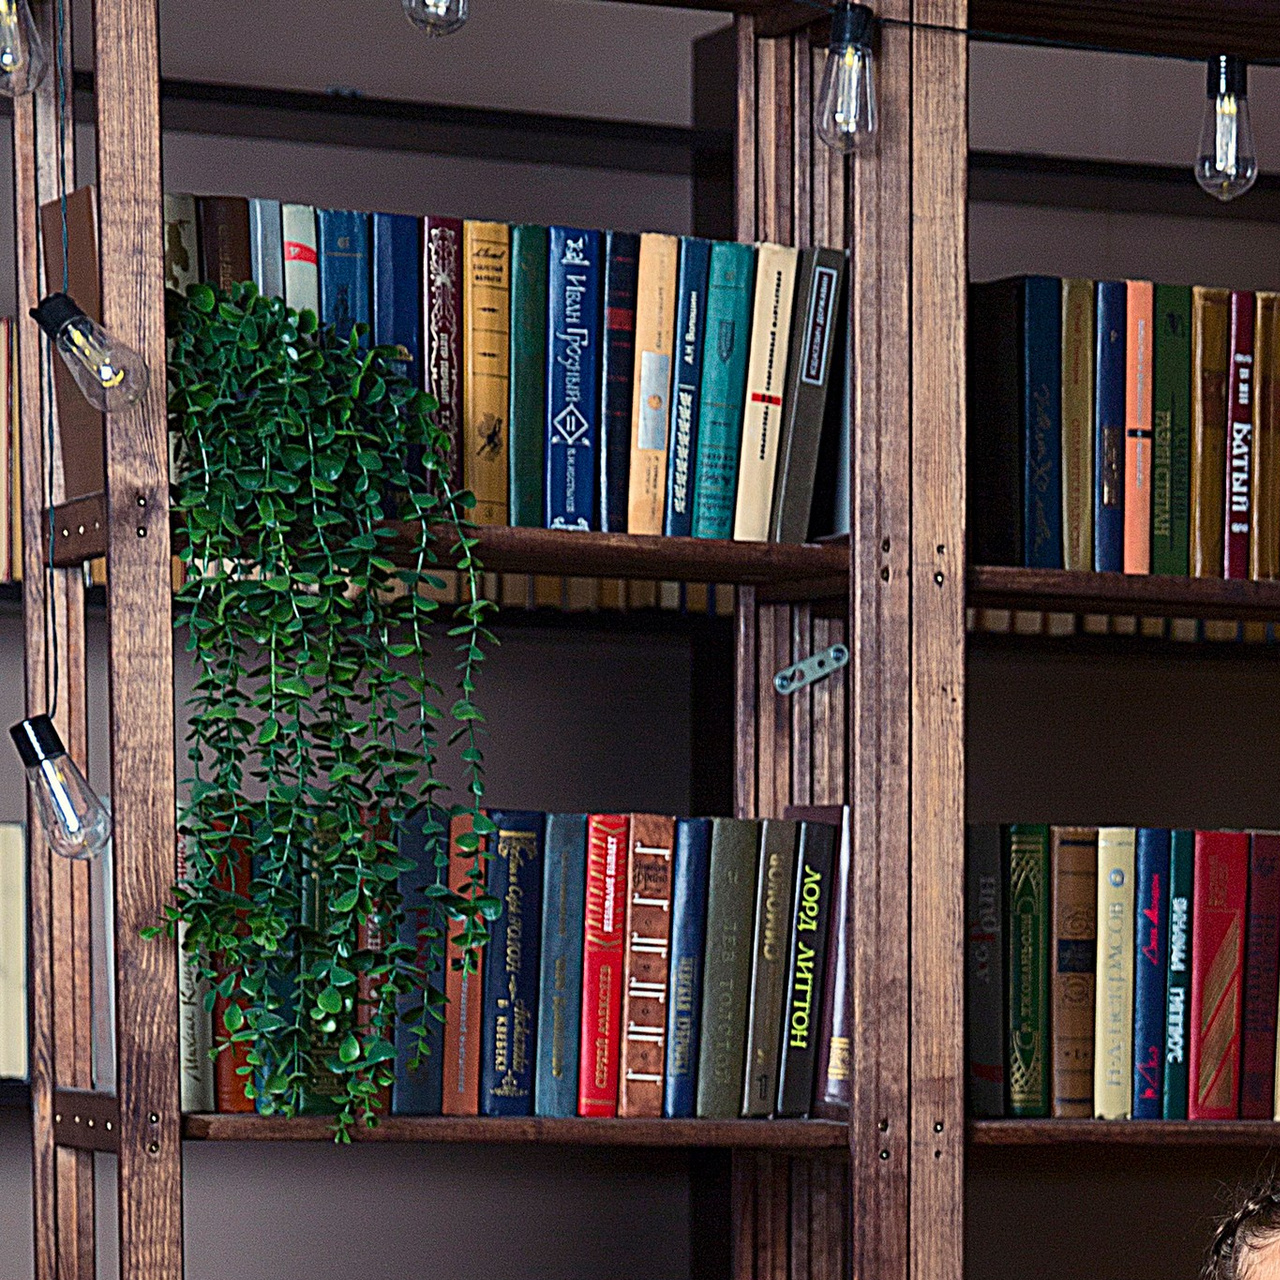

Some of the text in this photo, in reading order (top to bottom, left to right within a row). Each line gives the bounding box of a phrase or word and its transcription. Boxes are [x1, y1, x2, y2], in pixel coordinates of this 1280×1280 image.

[556, 275, 589, 403] Иван Грозный
[1232, 421, 1252, 512] БАТЫЙ
[763, 853, 780, 961] СИМОНОВ
[790, 865, 822, 1048] ЛОРД ЛИТТОН
